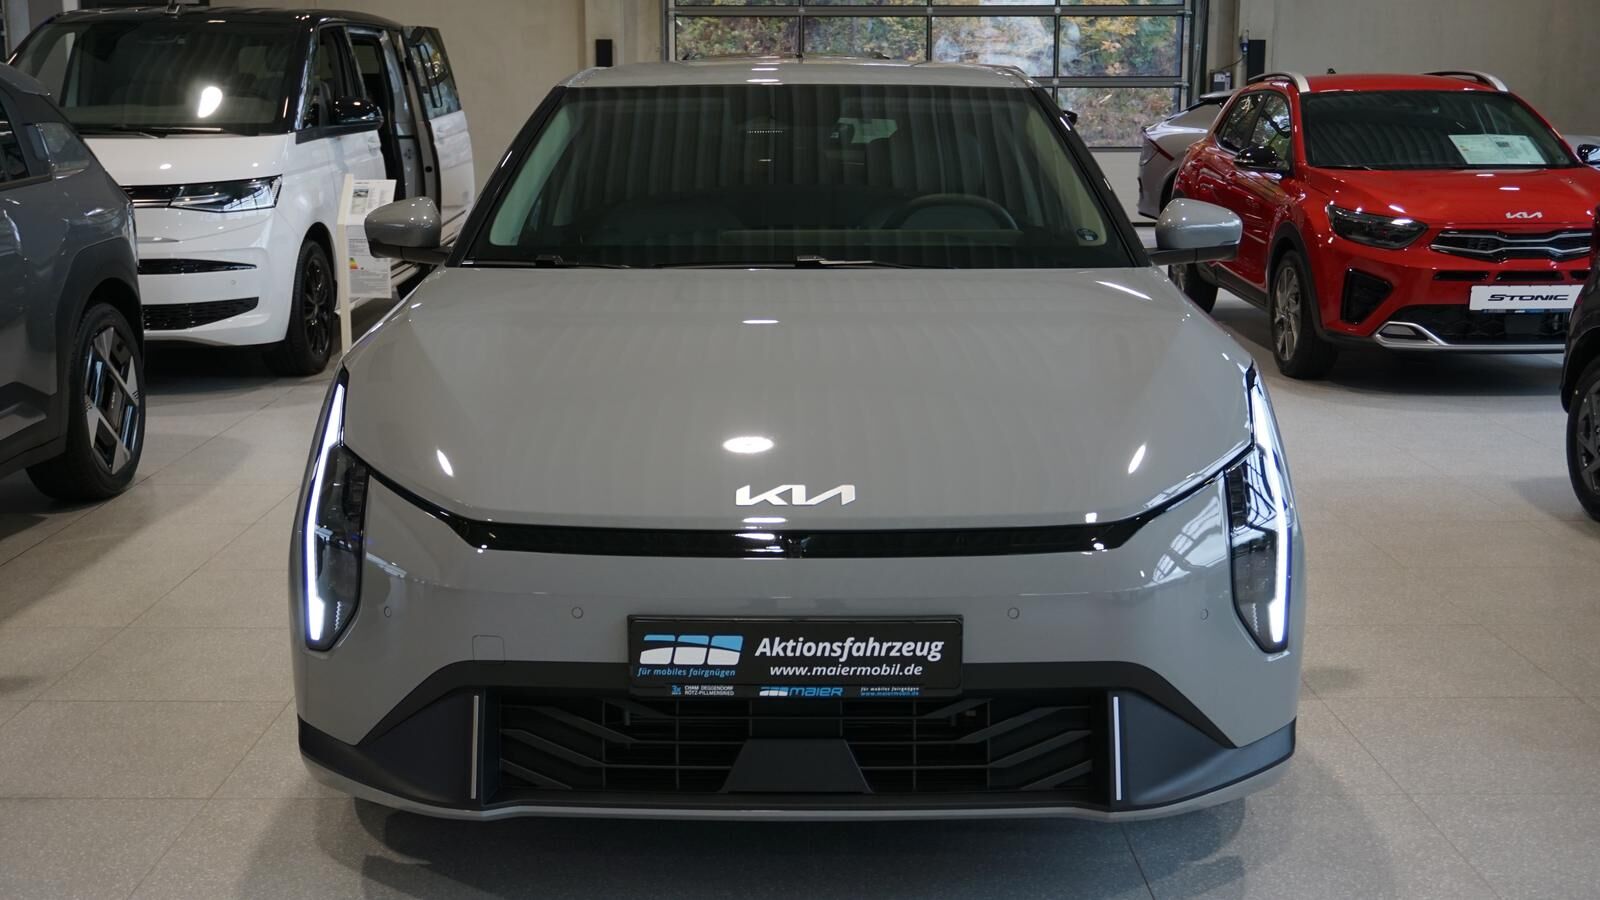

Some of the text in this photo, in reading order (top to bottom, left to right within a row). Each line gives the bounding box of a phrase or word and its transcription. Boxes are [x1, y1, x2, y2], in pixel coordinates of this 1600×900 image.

[1505, 211, 1543, 219] KIA
[1487, 294, 1569, 302] STONIC
[735, 484, 856, 506] KIA
[755, 637, 945, 662] Aktionsfahrzeug
[637, 667, 736, 678] für mobiles fairgnügen
[770, 664, 923, 676] www.maiermobil.de
